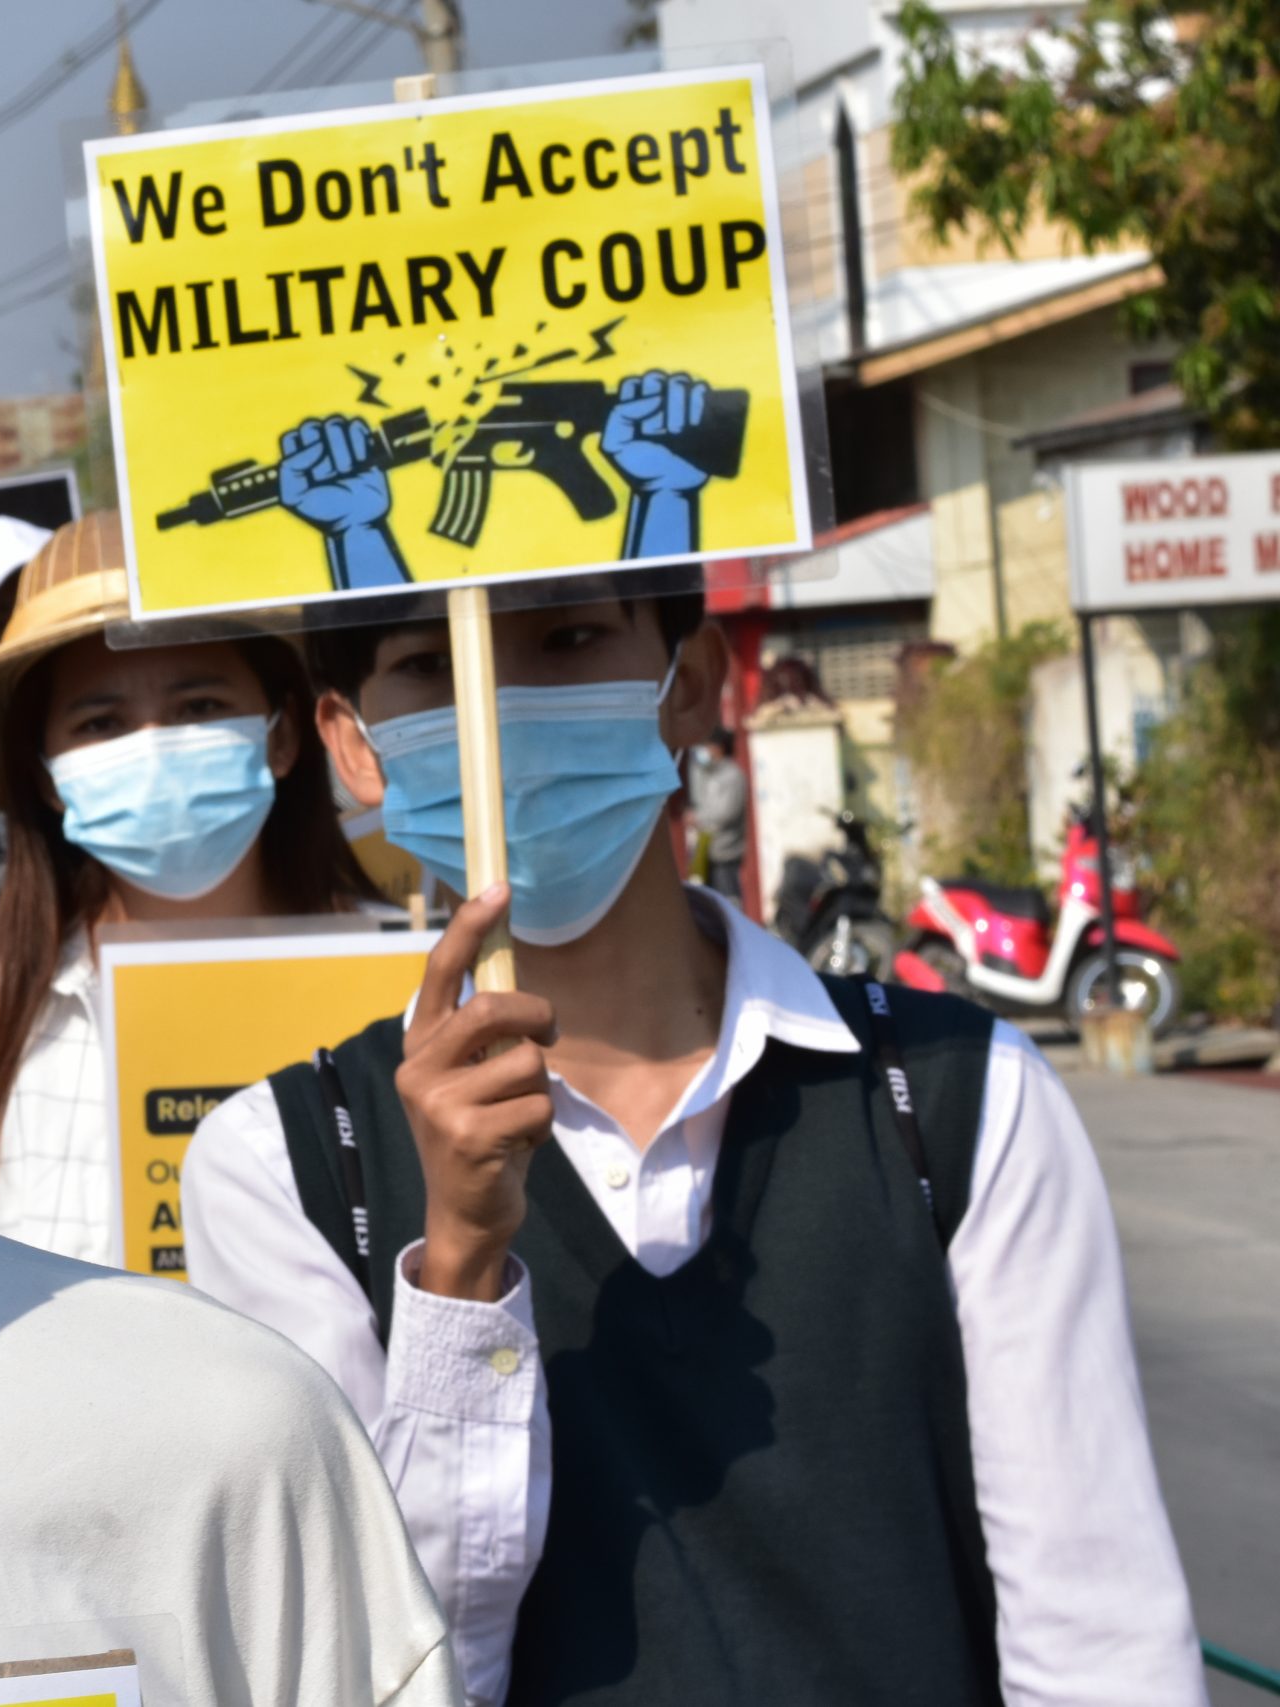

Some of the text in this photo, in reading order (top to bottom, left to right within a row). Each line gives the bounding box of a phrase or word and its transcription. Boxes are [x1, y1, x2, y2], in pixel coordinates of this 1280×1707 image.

[112, 107, 748, 244] We Don't Accept
[116, 219, 767, 360] MILITARY COUP
[1122, 475, 1228, 523] WOOD
[1124, 534, 1227, 585] HOME
